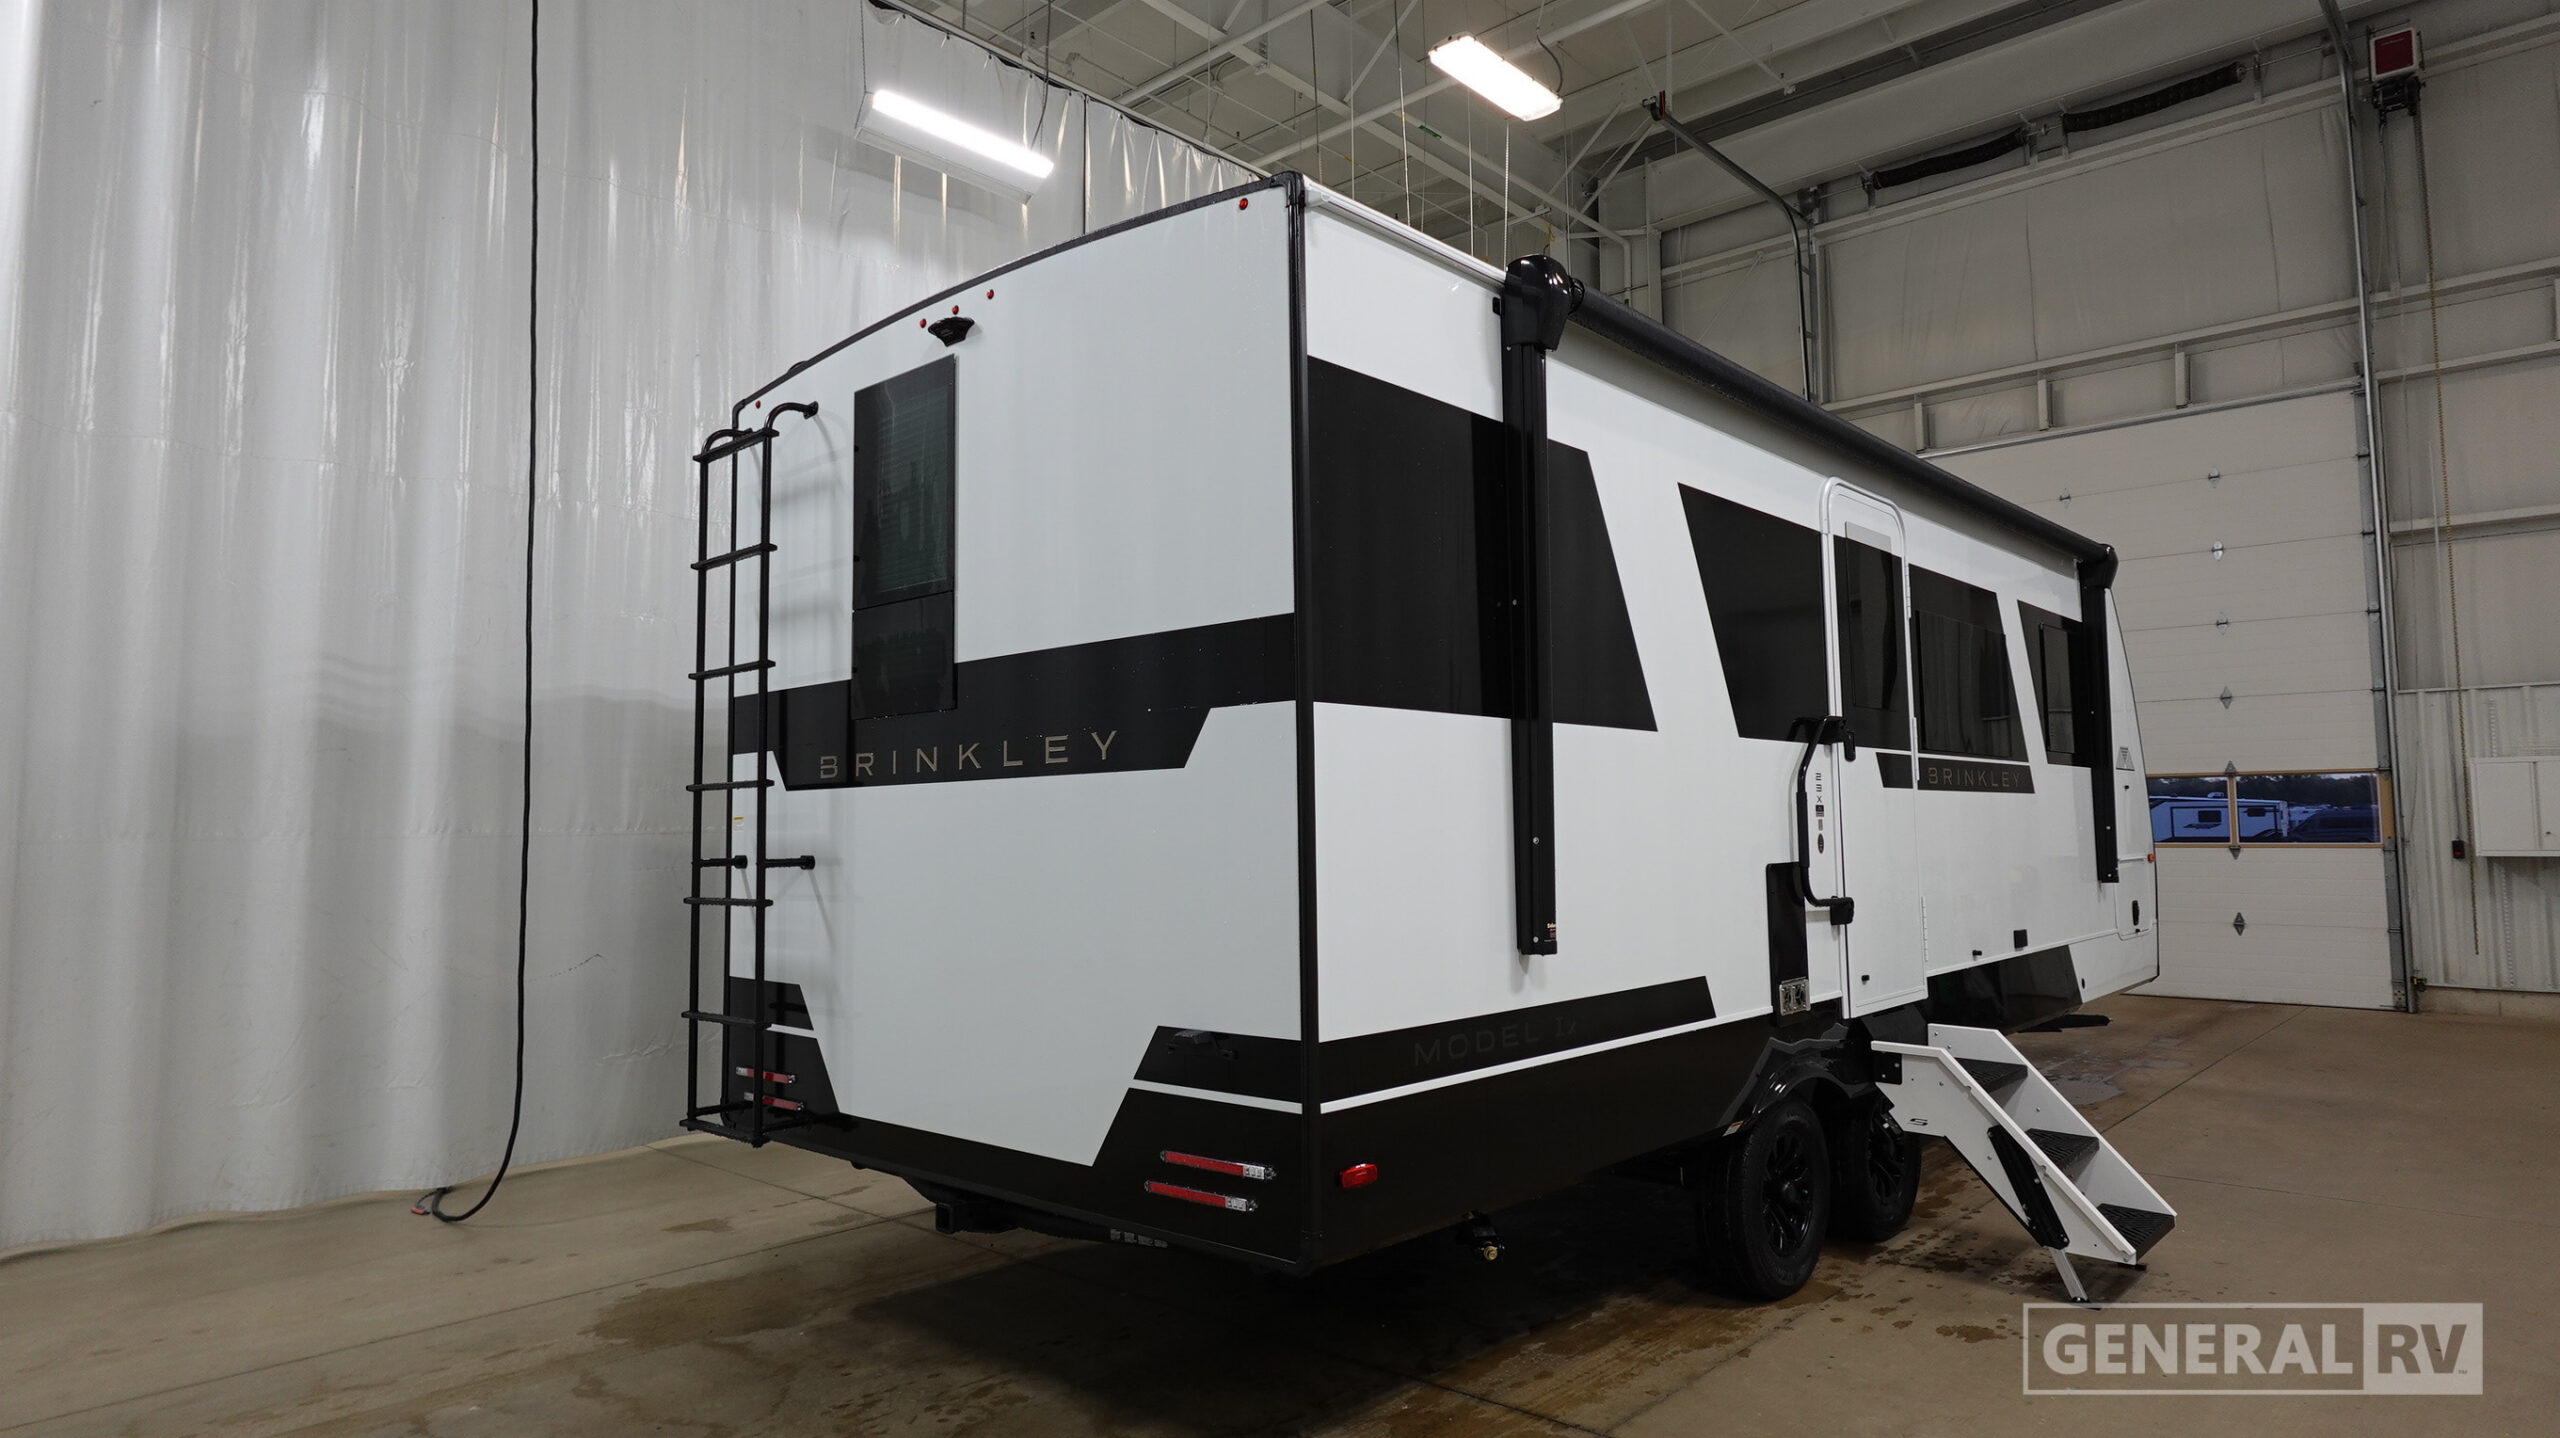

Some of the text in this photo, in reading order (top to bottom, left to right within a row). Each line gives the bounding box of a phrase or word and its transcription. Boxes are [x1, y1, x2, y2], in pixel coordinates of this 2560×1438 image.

[819, 729, 1118, 780] BRINKLEY
[1927, 766, 2021, 788] BRINKLEY
[1413, 1021, 1540, 1067] MODEL
